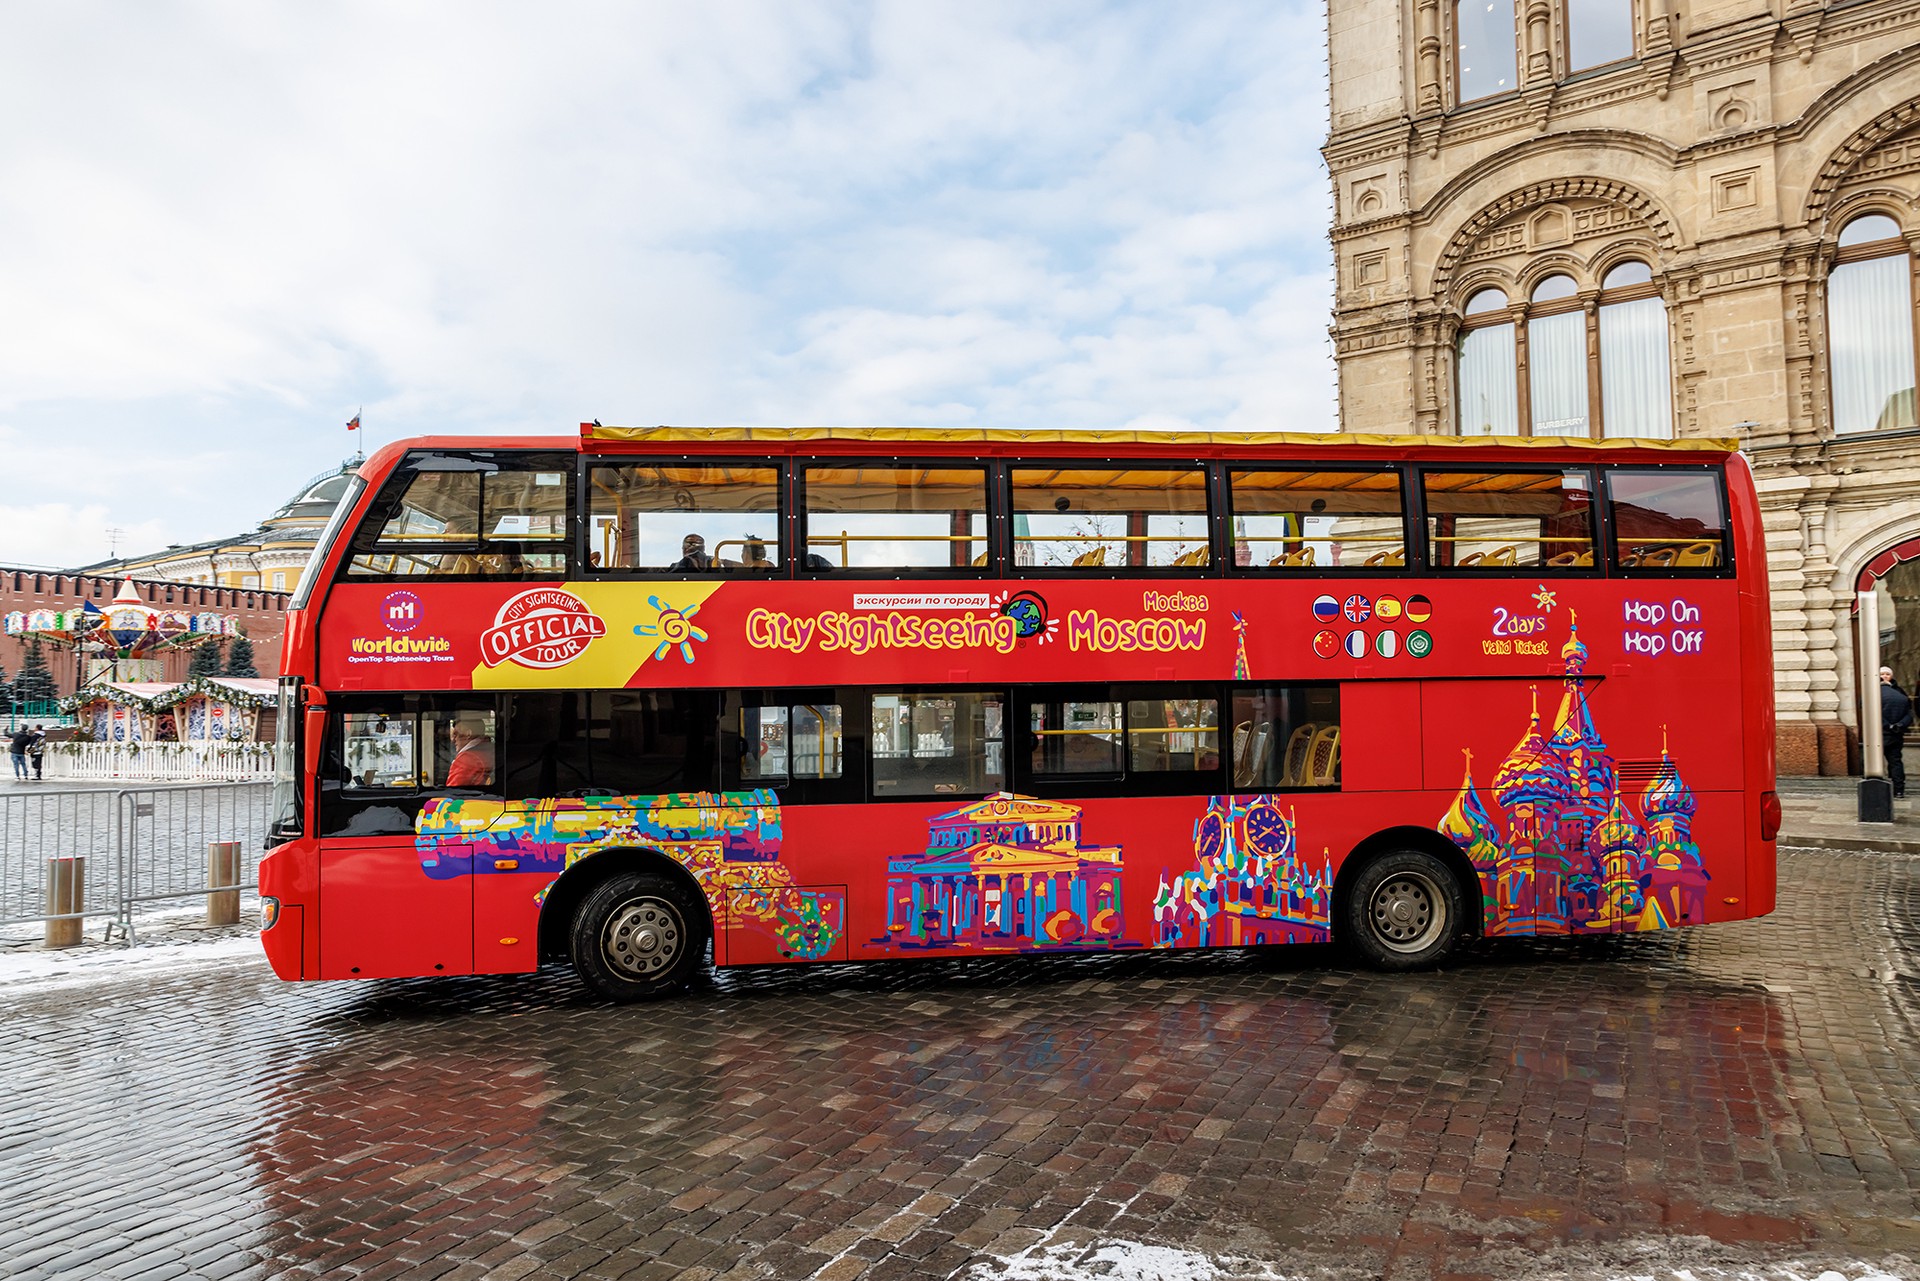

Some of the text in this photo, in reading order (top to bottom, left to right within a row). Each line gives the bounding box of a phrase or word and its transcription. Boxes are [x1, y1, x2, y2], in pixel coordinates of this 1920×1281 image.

[1536, 416, 1585, 430] BURBERRY
[508, 592, 581, 620] CITY SIGHTSEEING
[856, 596, 987, 607] экскурсии по городу
[1143, 590, 1209, 612] Москва
[1624, 599, 1699, 626] Hop On
[491, 616, 602, 656] OFFICIAL
[745, 607, 1017, 655] City Sightseeing
[1067, 609, 1206, 652] Moscow
[351, 635, 450, 654] Worldwide
[536, 640, 582, 662] TOUR
[1482, 638, 1550, 656] Valid Ticket
[1624, 629, 1704, 656] Hop Off
[347, 654, 455, 664] OpenTop Sightseeing Tours
